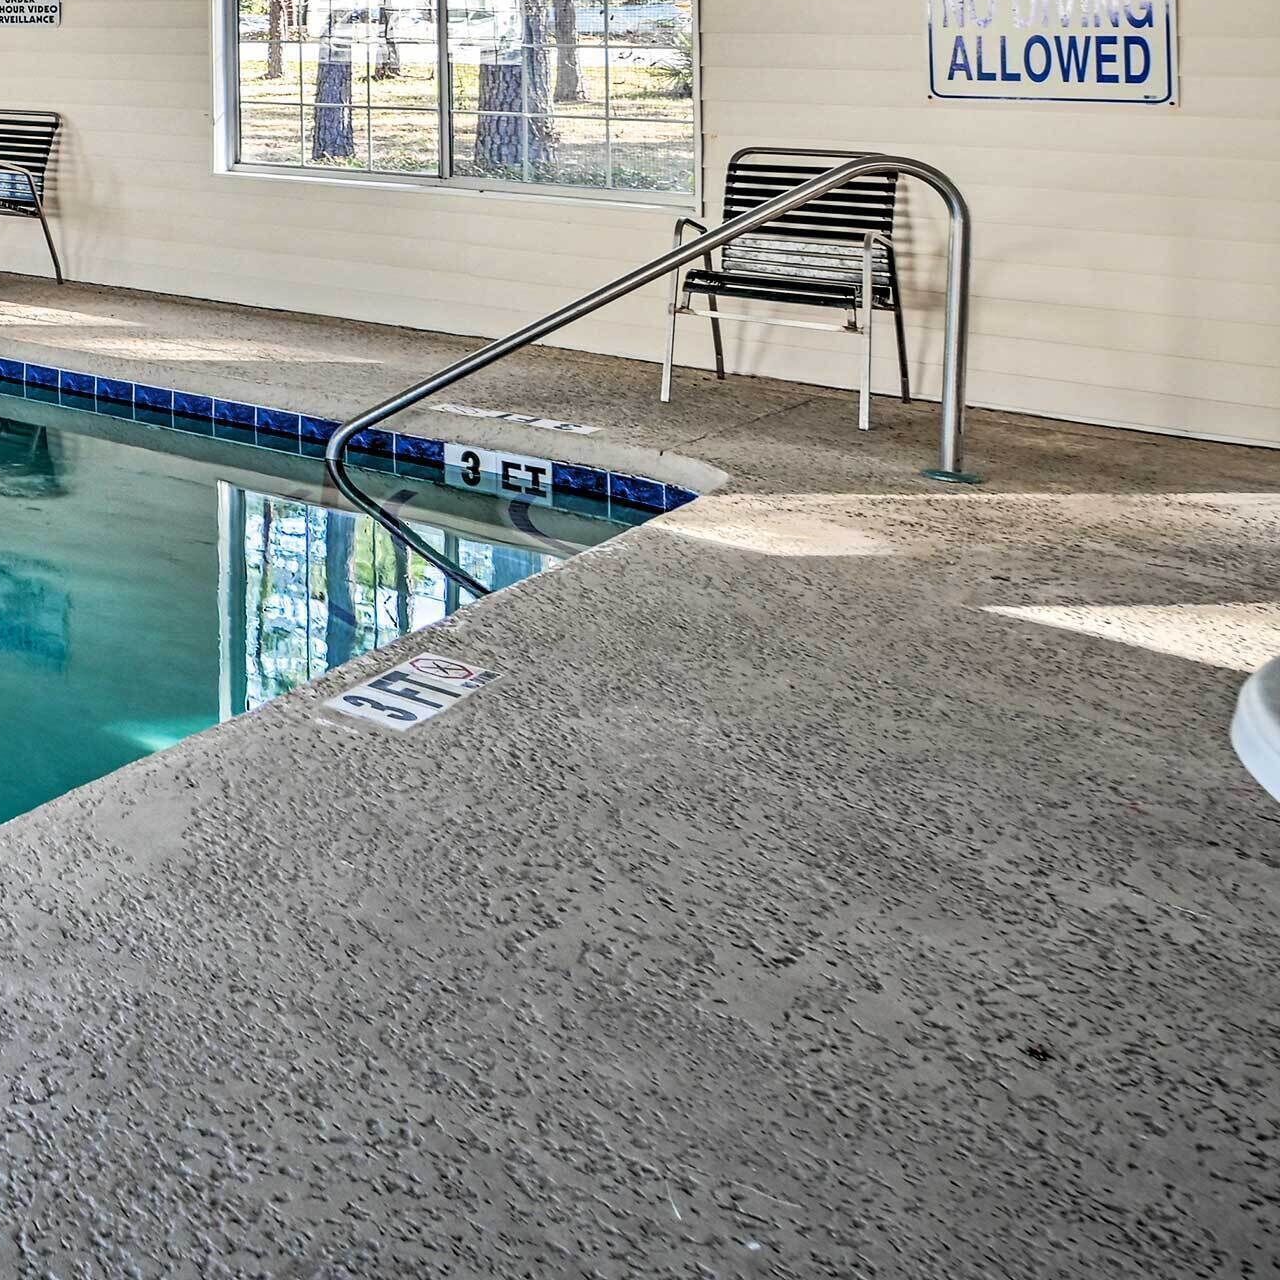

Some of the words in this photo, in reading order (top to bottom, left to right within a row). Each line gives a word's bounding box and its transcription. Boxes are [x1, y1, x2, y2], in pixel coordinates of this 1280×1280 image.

[0, 5, 25, 13] HOUR
[27, 5, 58, 13] VIDEO
[947, 34, 1152, 84] ALLOWED
[461, 450, 481, 487] 3
[342, 695, 418, 721] 3
[367, 670, 463, 709] FT
